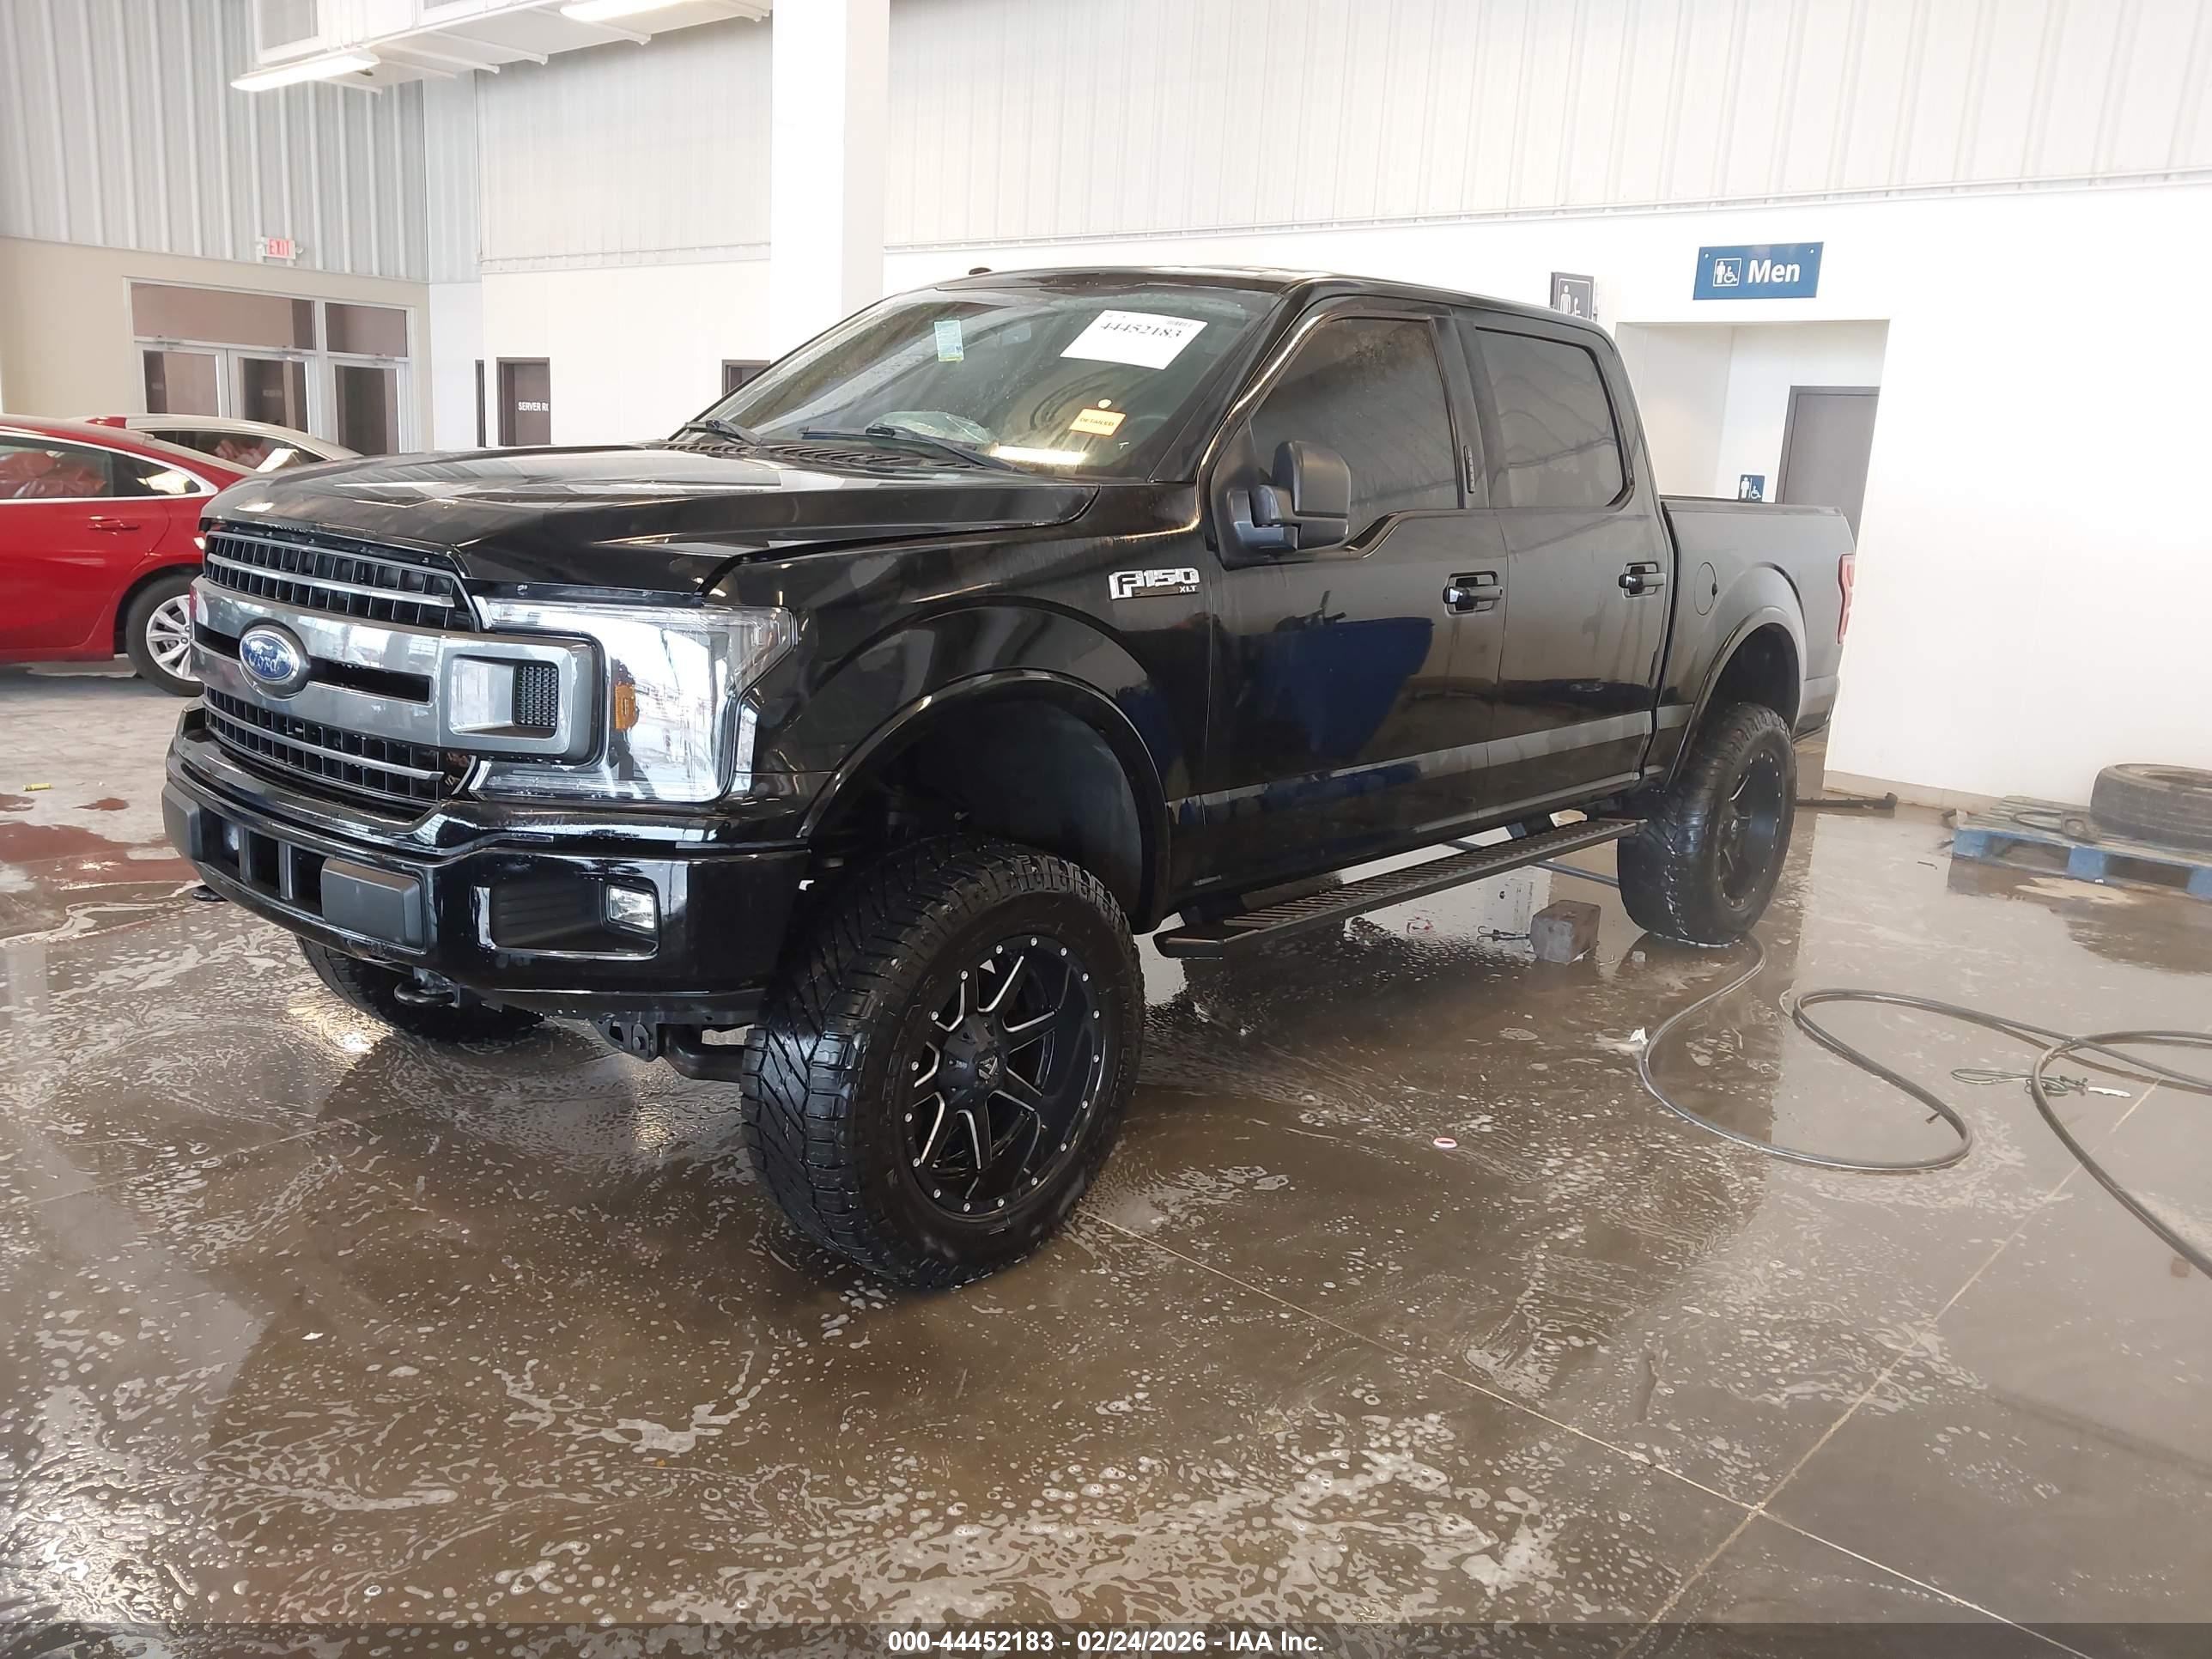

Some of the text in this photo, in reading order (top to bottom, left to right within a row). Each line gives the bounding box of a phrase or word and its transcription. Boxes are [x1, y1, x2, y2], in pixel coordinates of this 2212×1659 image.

[269, 239, 289, 256] EXIT
[1747, 258, 1801, 283] Men
[1100, 322, 1182, 338] 44452183
[518, 401, 541, 411] SERVER
[1079, 417, 1115, 427] DETAILED
[248, 640, 282, 673] Ford
